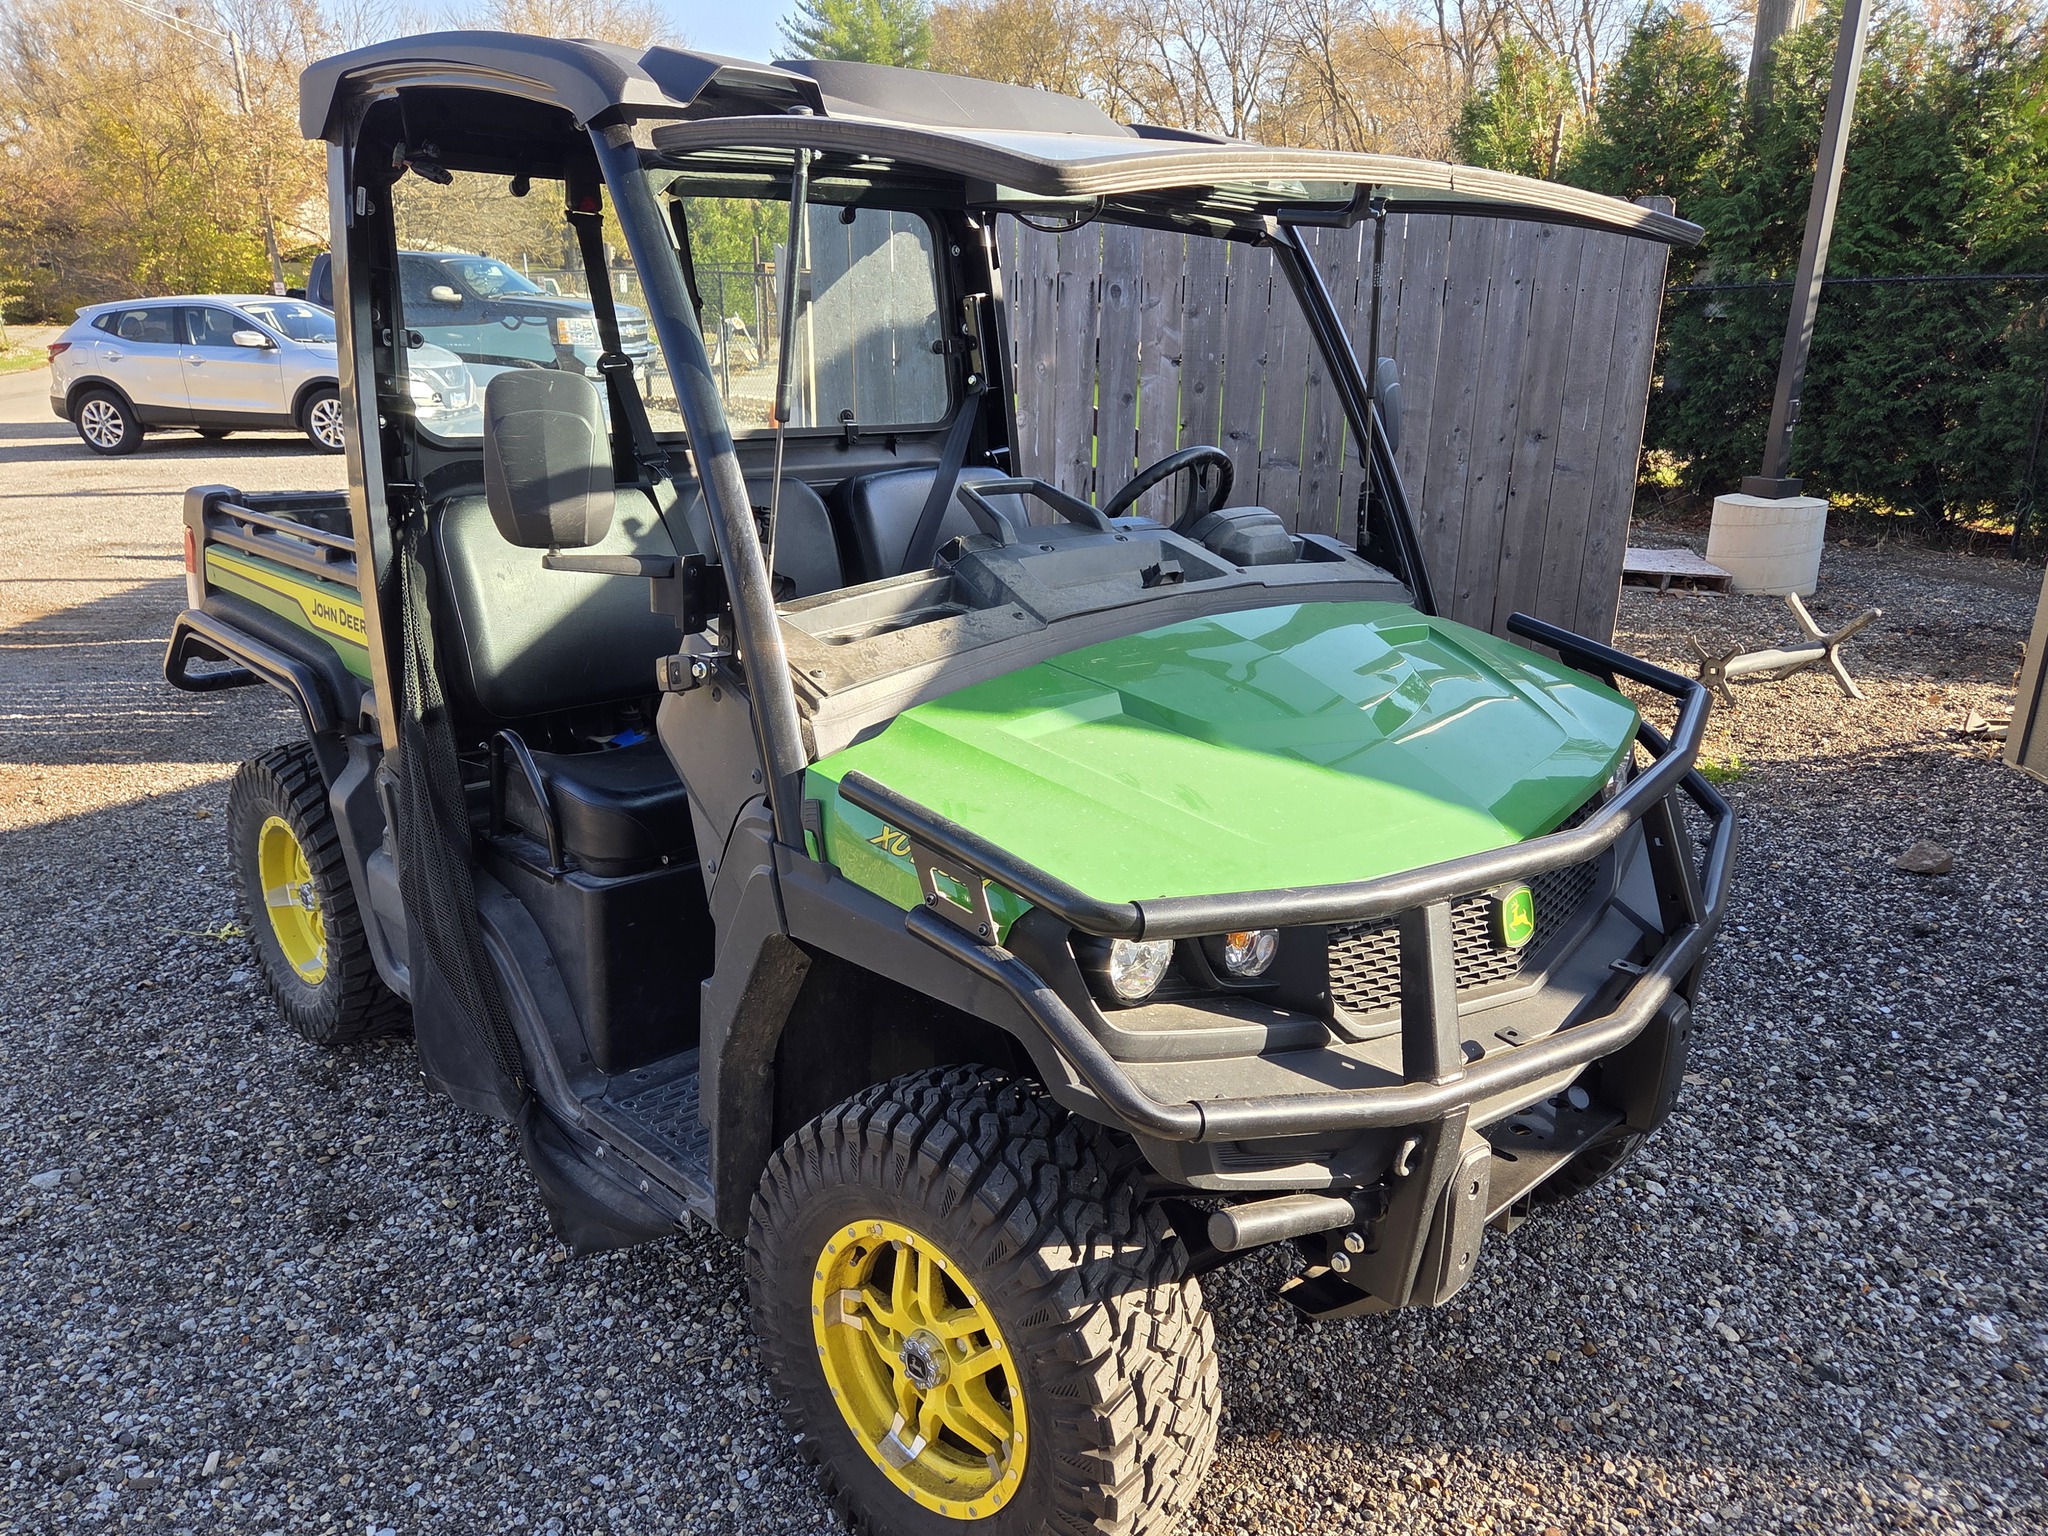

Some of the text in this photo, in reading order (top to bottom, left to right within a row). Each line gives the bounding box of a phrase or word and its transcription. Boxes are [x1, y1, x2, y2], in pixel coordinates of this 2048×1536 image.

[312, 598, 367, 635] JOHN DEER
[869, 824, 914, 862] XU
